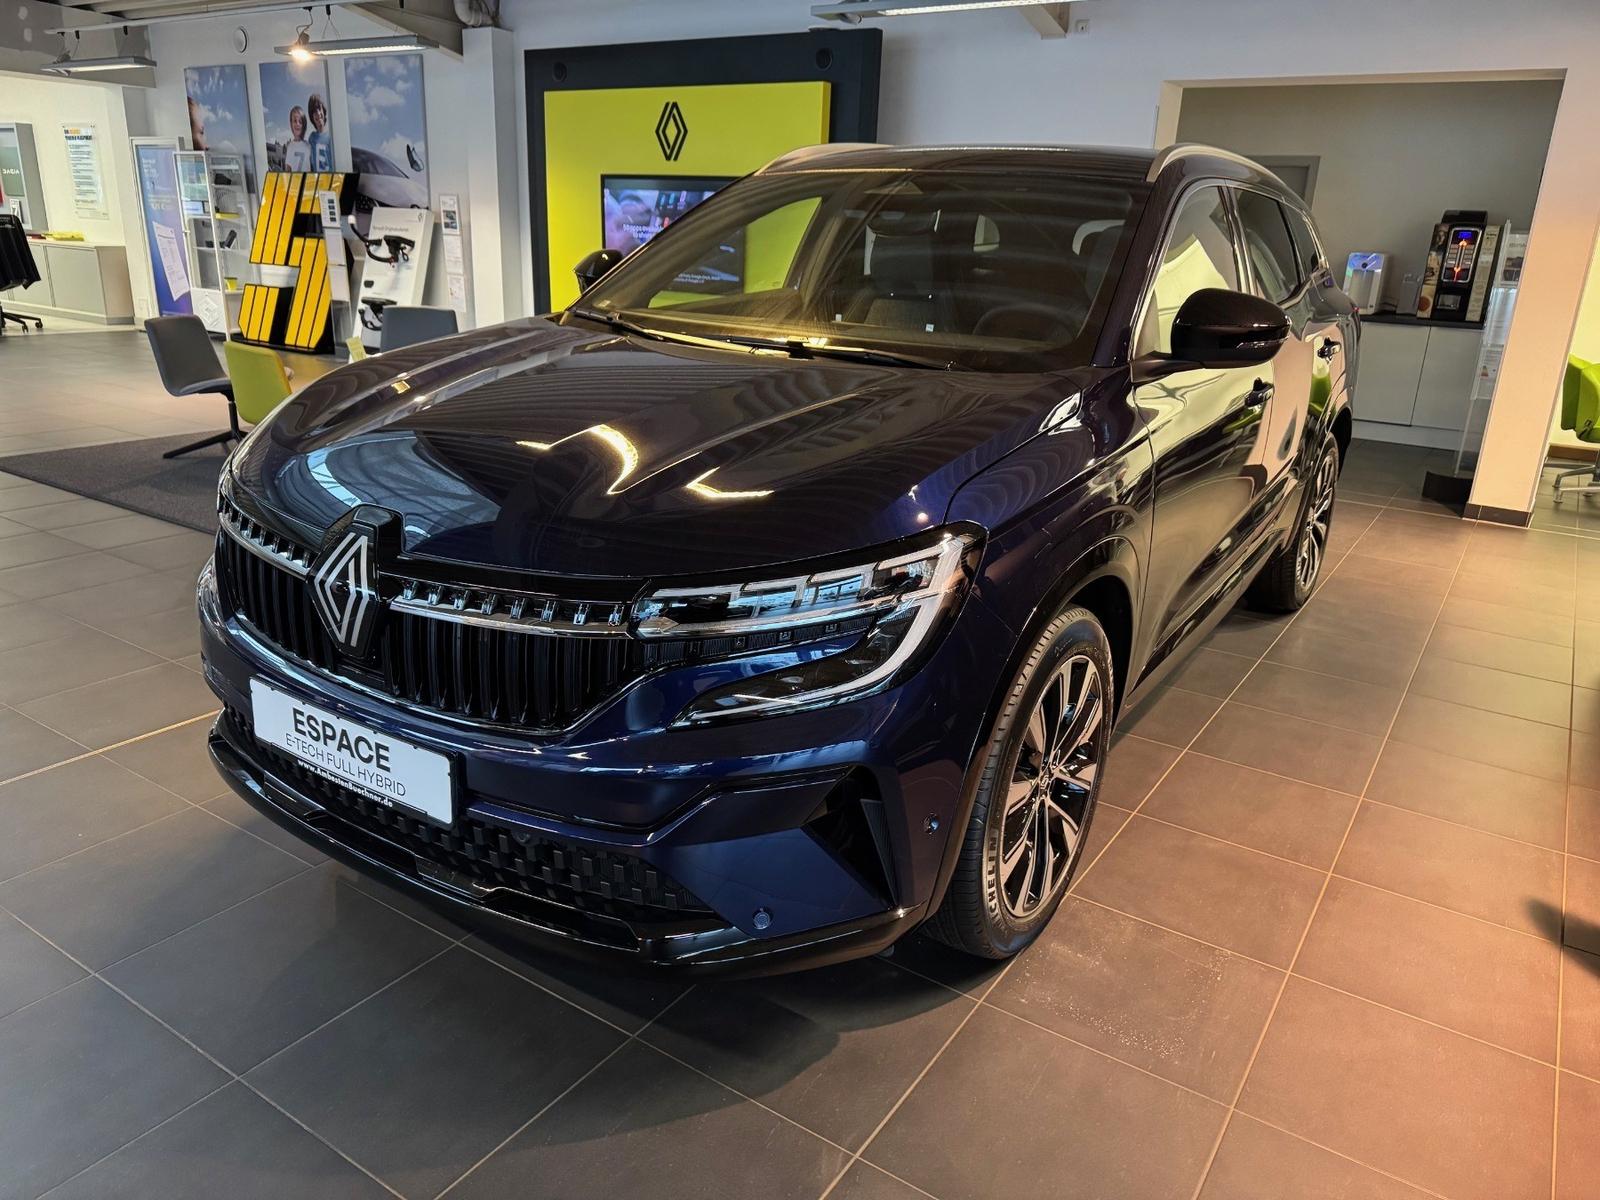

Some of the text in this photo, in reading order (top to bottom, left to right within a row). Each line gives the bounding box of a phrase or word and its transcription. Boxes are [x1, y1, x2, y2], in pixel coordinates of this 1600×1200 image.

[286, 733, 406, 796] E-TECH FULL HYBRID
[292, 707, 391, 772] ESPACE
